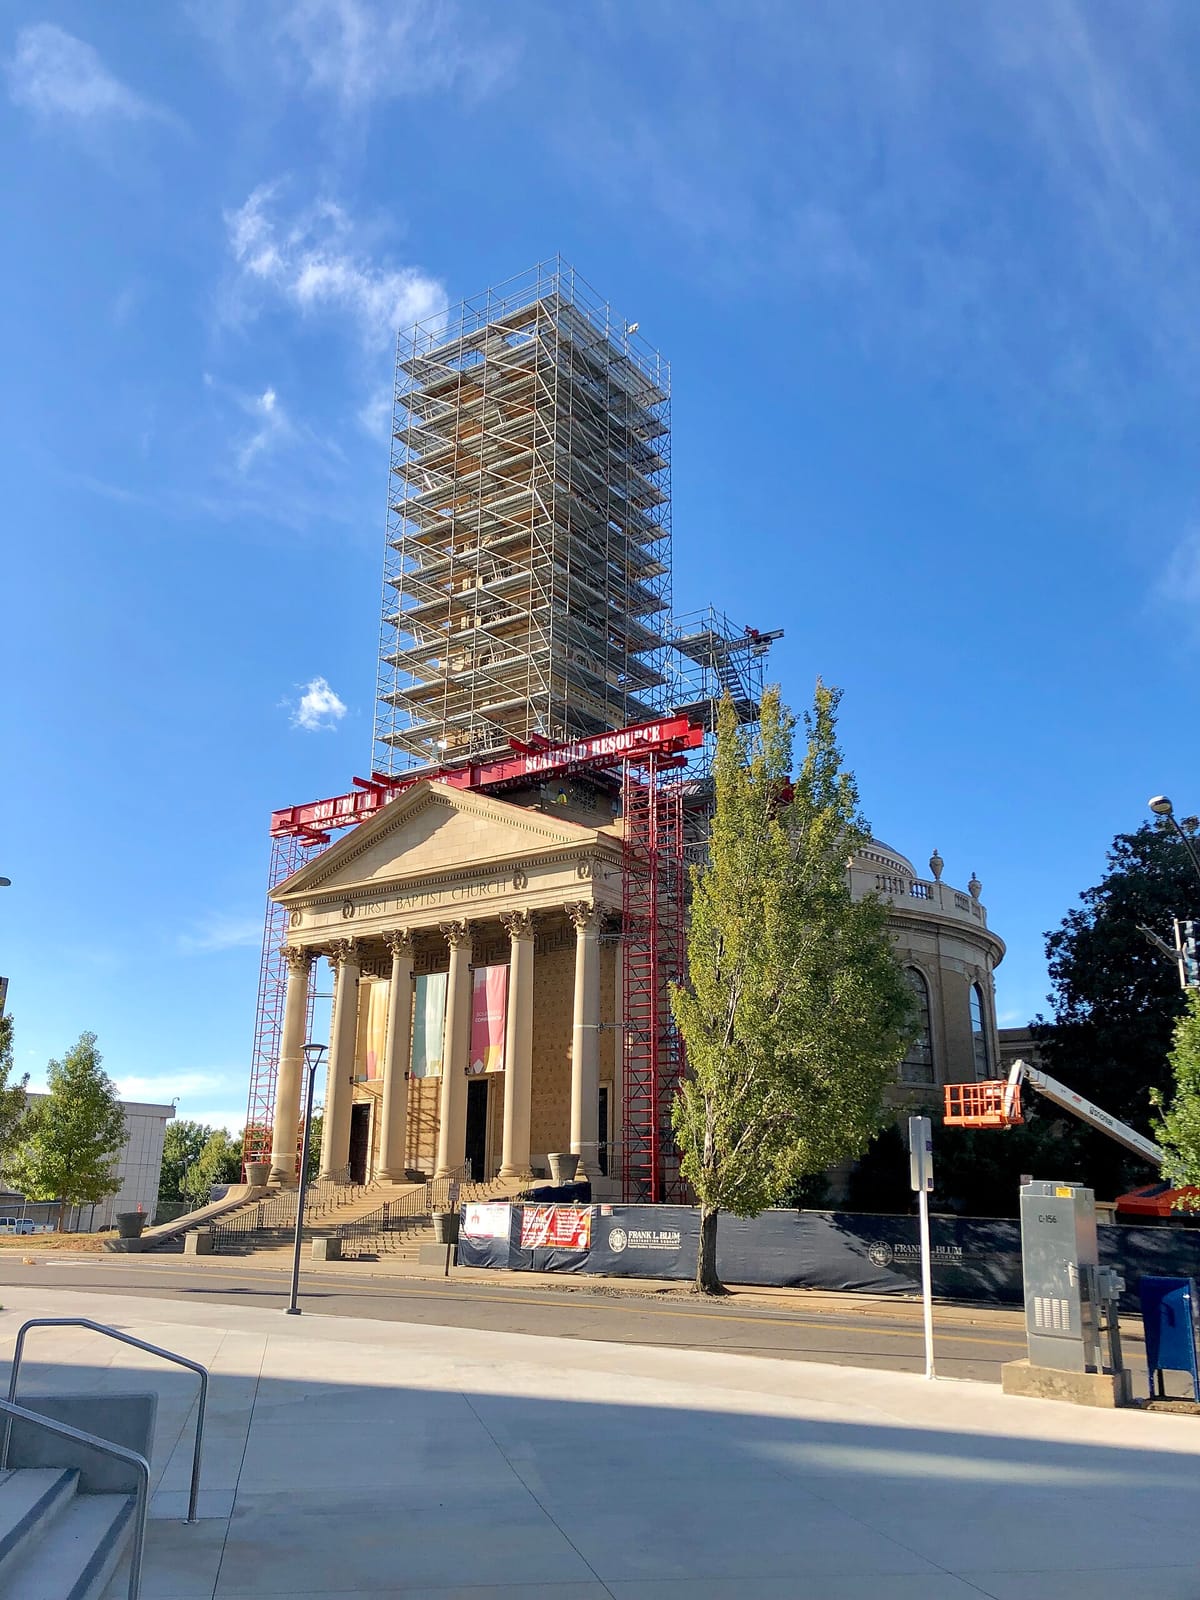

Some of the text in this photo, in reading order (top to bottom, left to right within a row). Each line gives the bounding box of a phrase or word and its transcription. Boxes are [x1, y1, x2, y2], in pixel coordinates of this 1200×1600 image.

[592, 725, 660, 757] RESOURCE
[358, 878, 506, 916] FIRST BAPTIST CHURCH
[1038, 1214, 1057, 1223] C-156
[628, 1230, 652, 1239] FRANK
[660, 1231, 680, 1240] BLUM
[935, 1245, 963, 1255] BLUM
